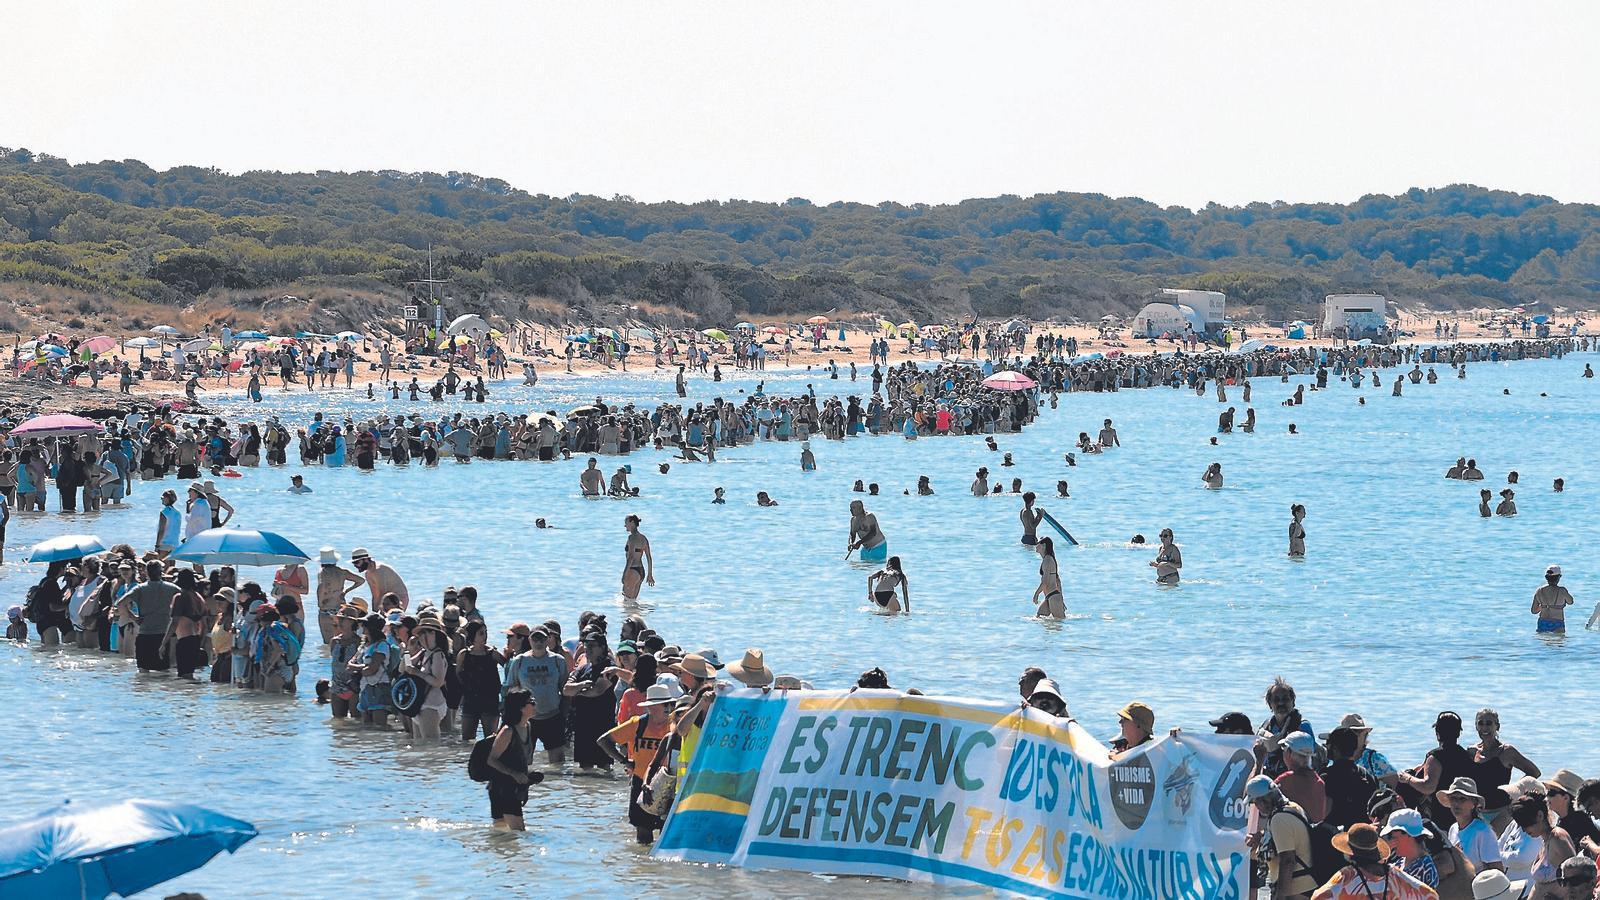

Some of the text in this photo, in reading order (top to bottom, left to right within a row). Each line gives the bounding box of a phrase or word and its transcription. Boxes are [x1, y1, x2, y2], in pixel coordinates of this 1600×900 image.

[779, 715, 838, 774] ES
[839, 716, 997, 792] TRENC
[758, 786, 956, 854] DEFENSEM
